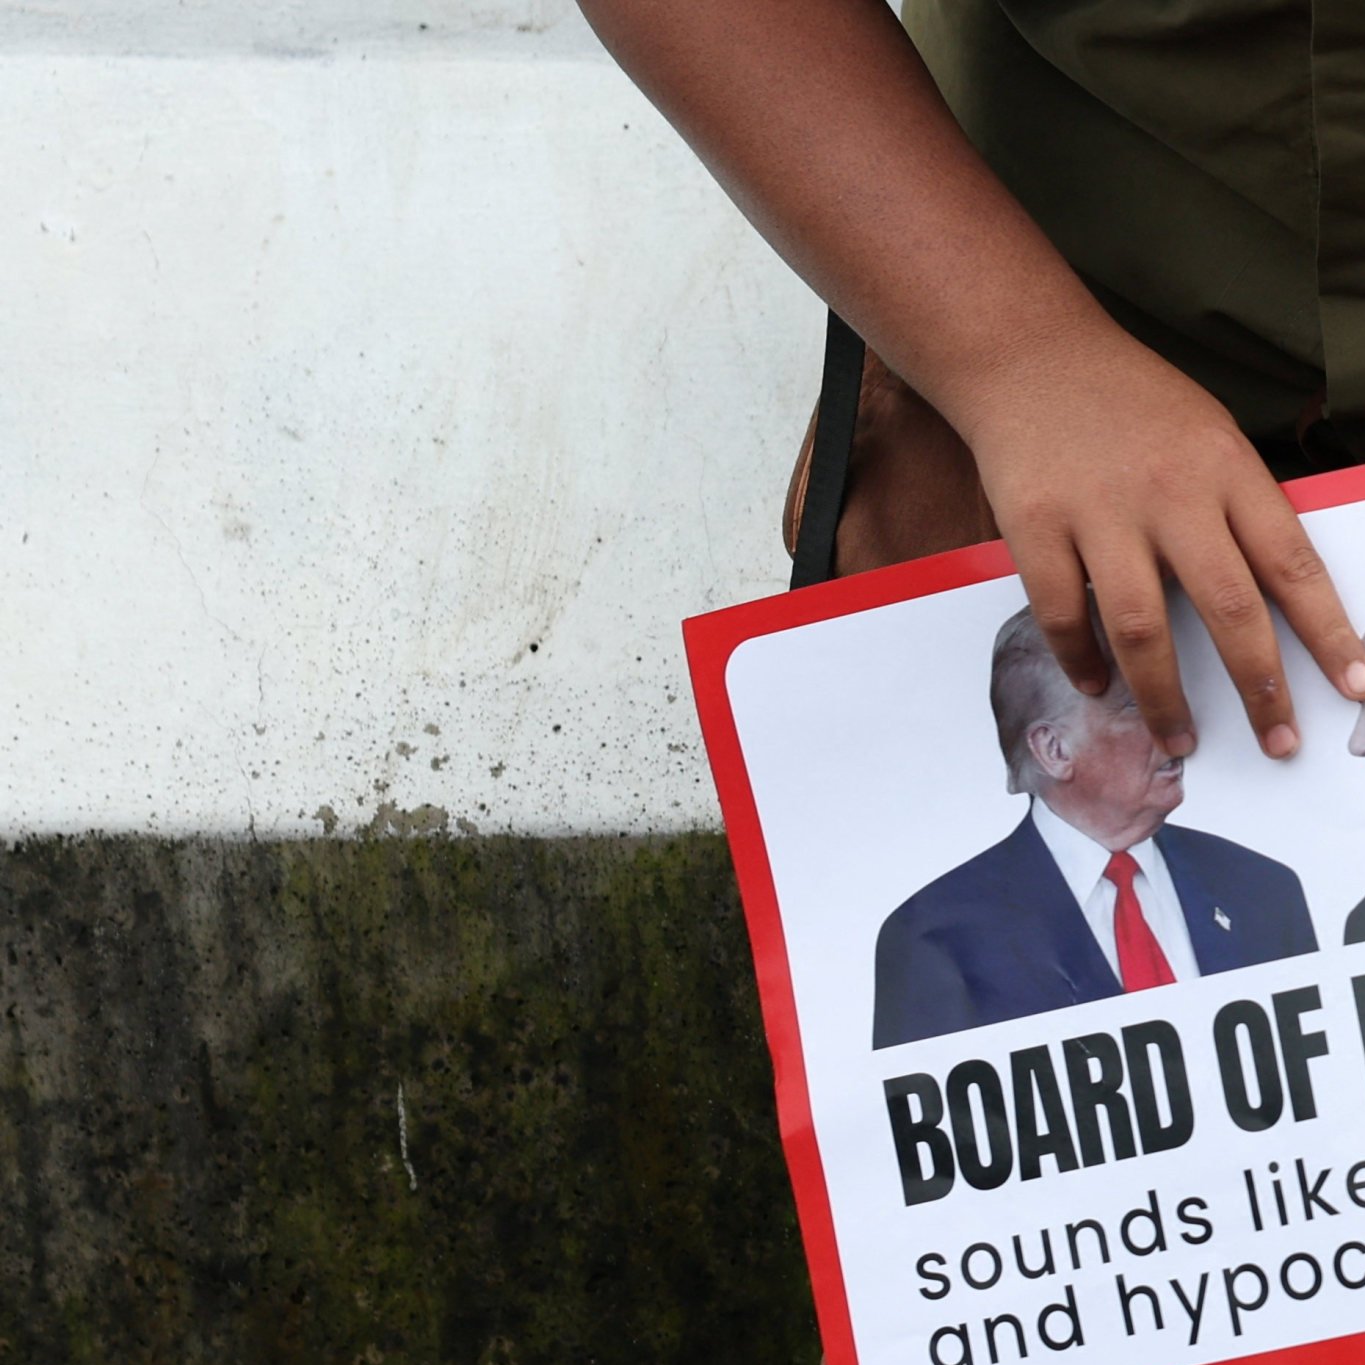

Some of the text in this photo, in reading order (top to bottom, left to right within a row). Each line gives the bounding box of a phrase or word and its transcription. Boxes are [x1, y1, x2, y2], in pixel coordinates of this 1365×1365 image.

[883, 1020, 1195, 1206] BOARD
[1213, 985, 1330, 1132] OF
[916, 1190, 1213, 1300] sounds
